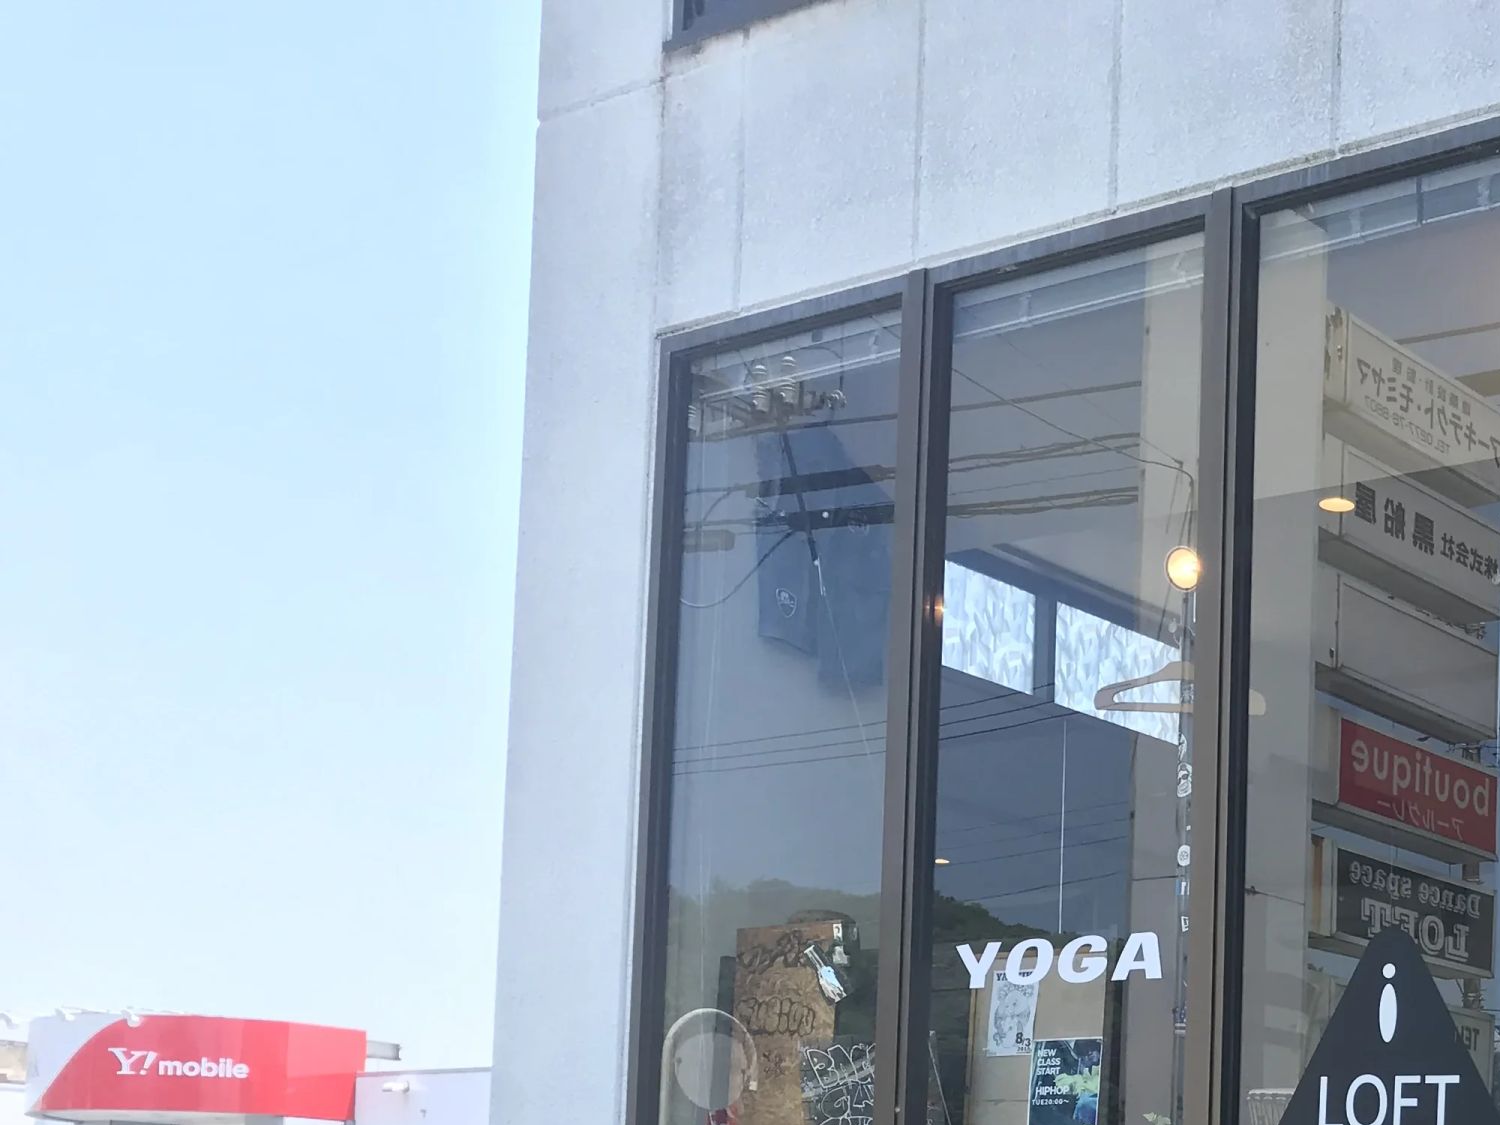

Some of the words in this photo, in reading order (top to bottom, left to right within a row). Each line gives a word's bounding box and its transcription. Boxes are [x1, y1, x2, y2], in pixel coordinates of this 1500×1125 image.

[956, 931, 1163, 989] YOGA
[1037, 1048, 1057, 1057] NEW
[1037, 1057, 1061, 1066] CLASS
[1036, 1067, 1061, 1076] START
[1035, 1085, 1070, 1096] HIPHOP
